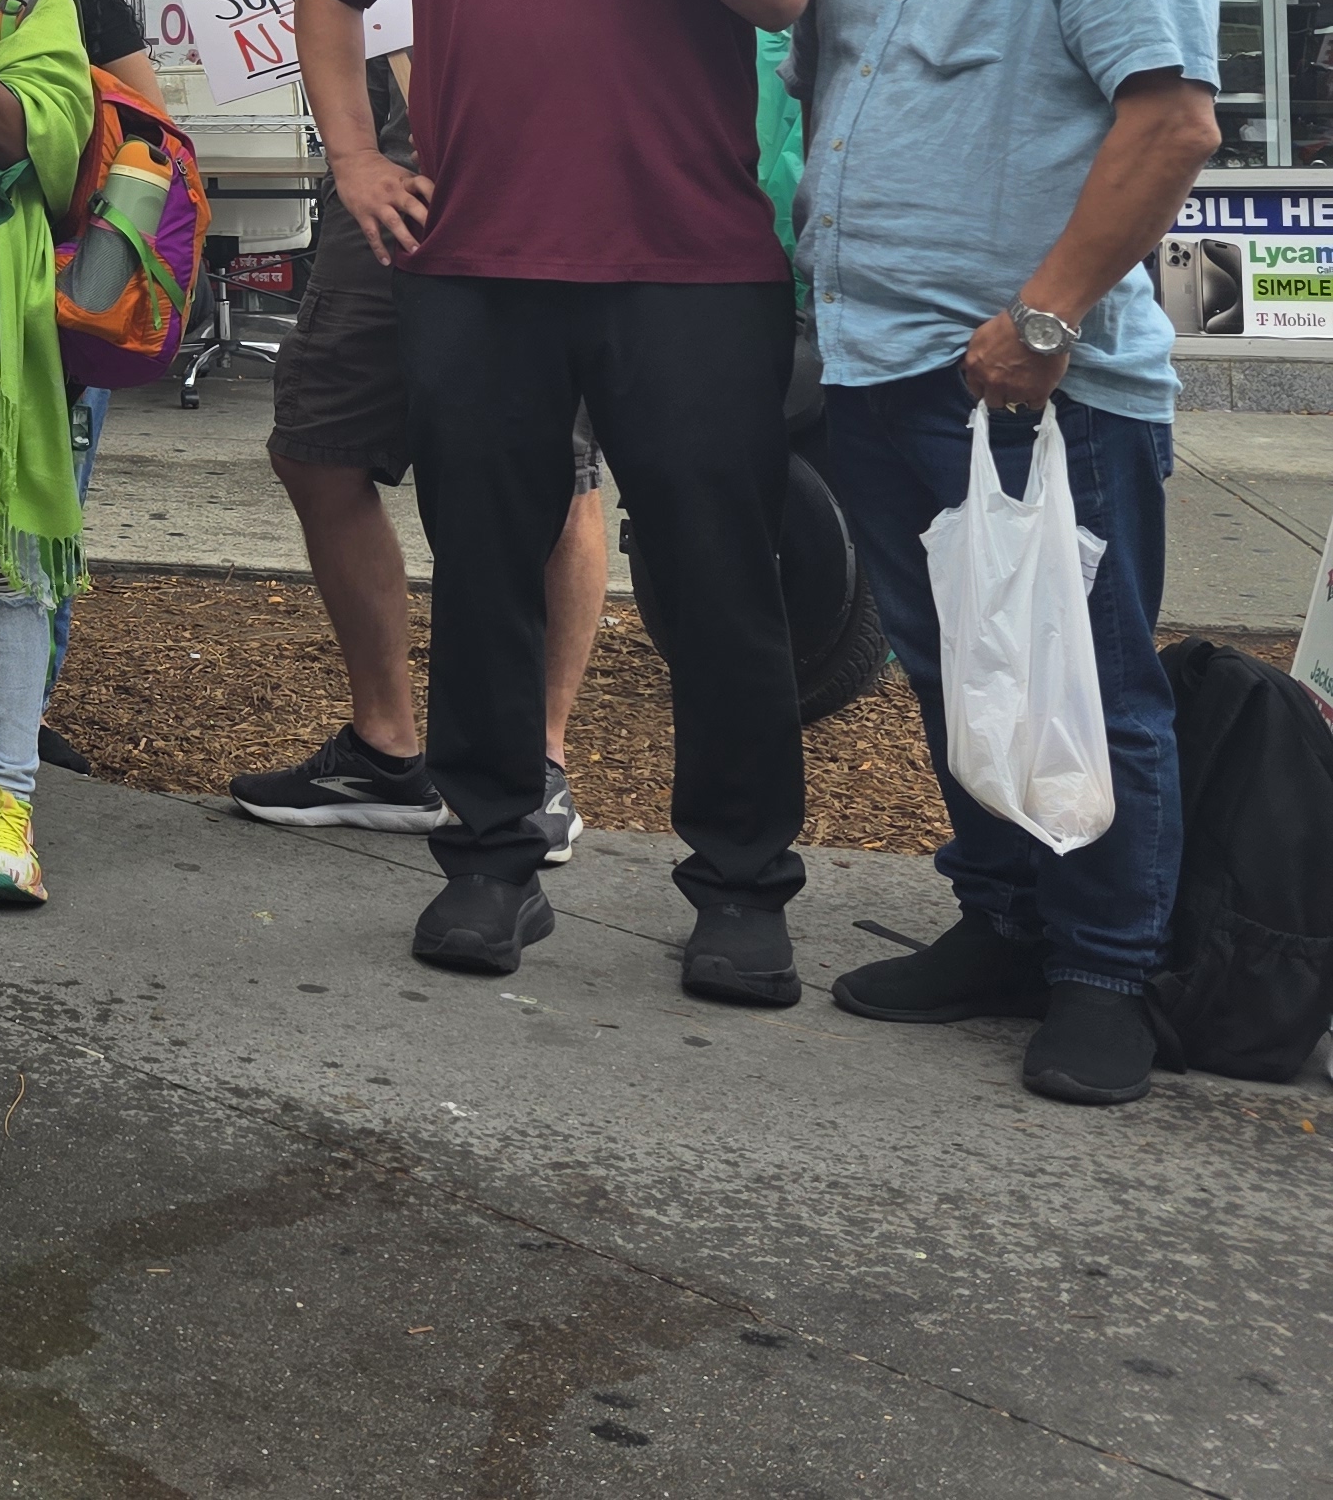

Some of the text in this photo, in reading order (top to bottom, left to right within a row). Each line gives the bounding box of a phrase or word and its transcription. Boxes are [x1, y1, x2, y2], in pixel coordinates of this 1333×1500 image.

[1176, 197, 1268, 228] BILL
[1257, 278, 1332, 297] SIMPLE
[1273, 312, 1326, 328] Mobile
